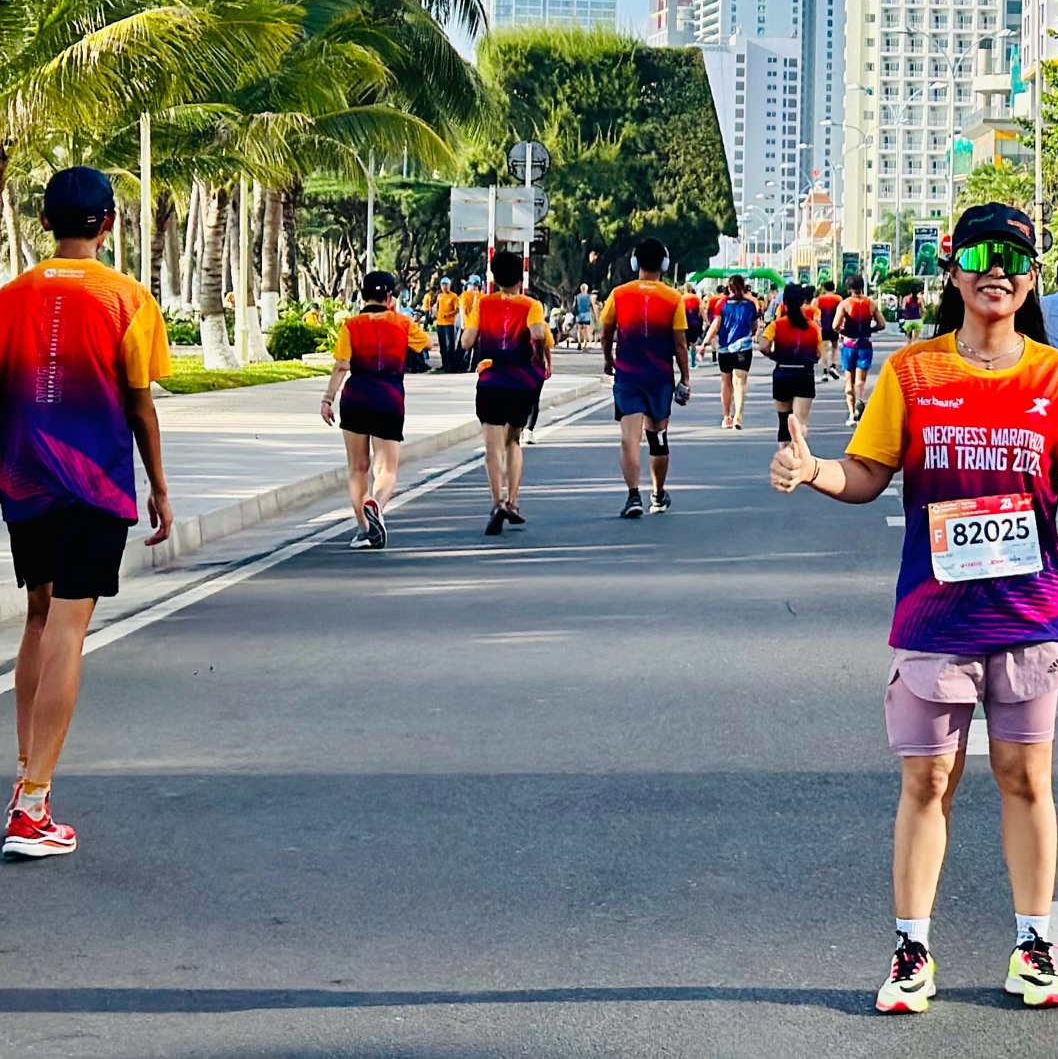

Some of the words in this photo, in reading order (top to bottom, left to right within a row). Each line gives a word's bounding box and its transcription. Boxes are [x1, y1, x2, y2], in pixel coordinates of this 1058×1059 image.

[917, 396, 960, 408] Herbalife
[955, 446, 1008, 471] TRANG
[934, 529, 943, 543] F
[953, 517, 1030, 546] 82025
